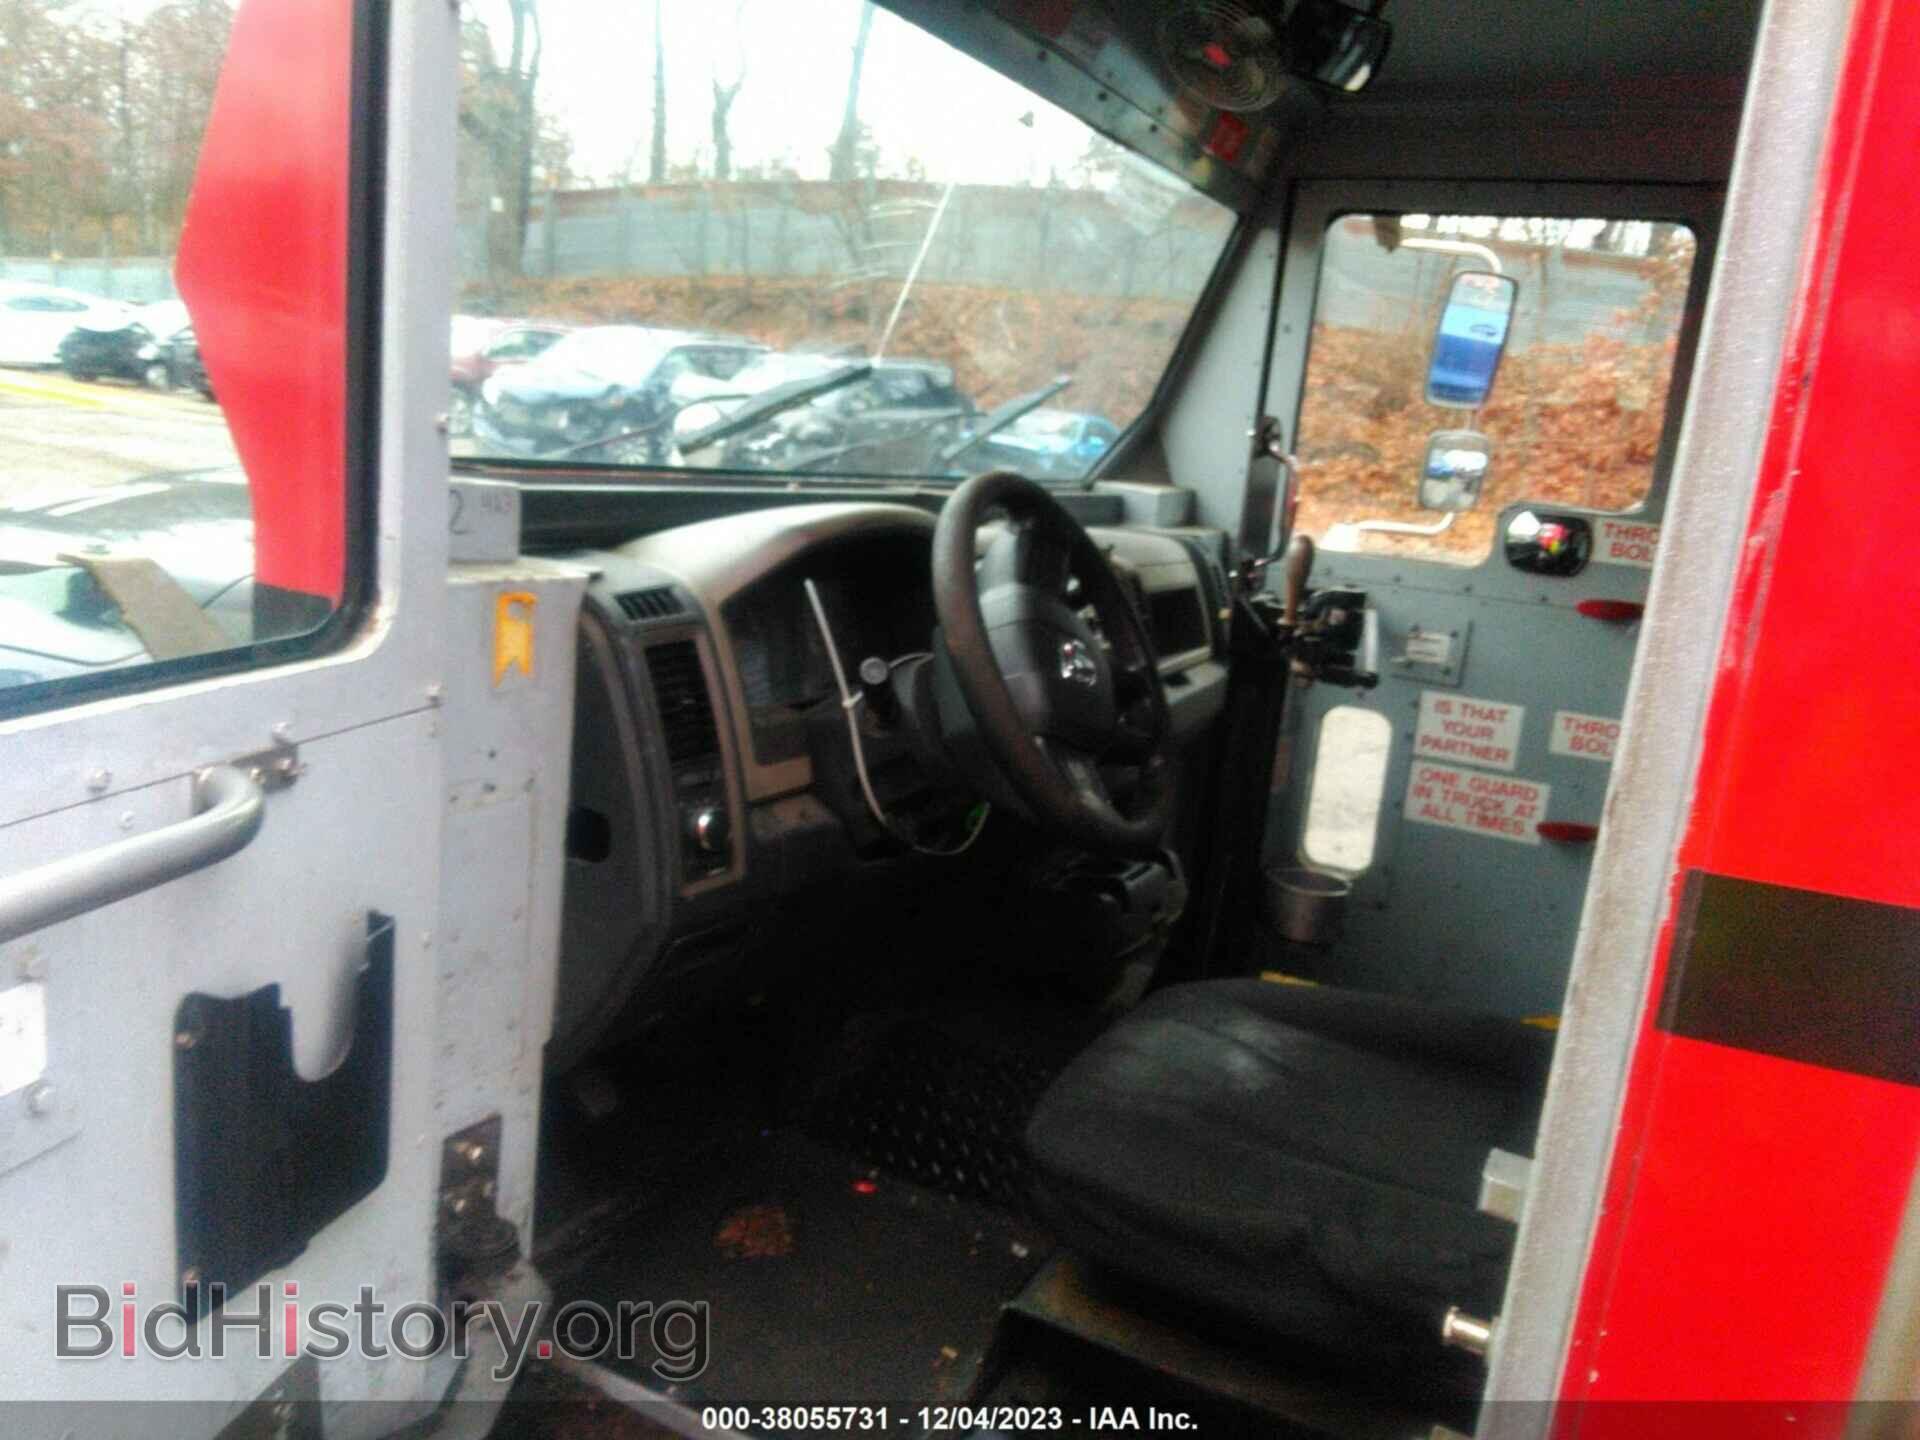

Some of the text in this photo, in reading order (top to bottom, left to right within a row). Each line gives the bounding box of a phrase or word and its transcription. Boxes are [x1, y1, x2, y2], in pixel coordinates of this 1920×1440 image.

[1434, 700, 1508, 722] IS THAT
[1442, 720, 1494, 738] YOUR
[1420, 735, 1511, 762] PARTNER
[1419, 768, 1539, 802] ONE GUARD
[1413, 784, 1537, 817] IN TRUCK AT
[1420, 803, 1526, 836] ALL TIMES
